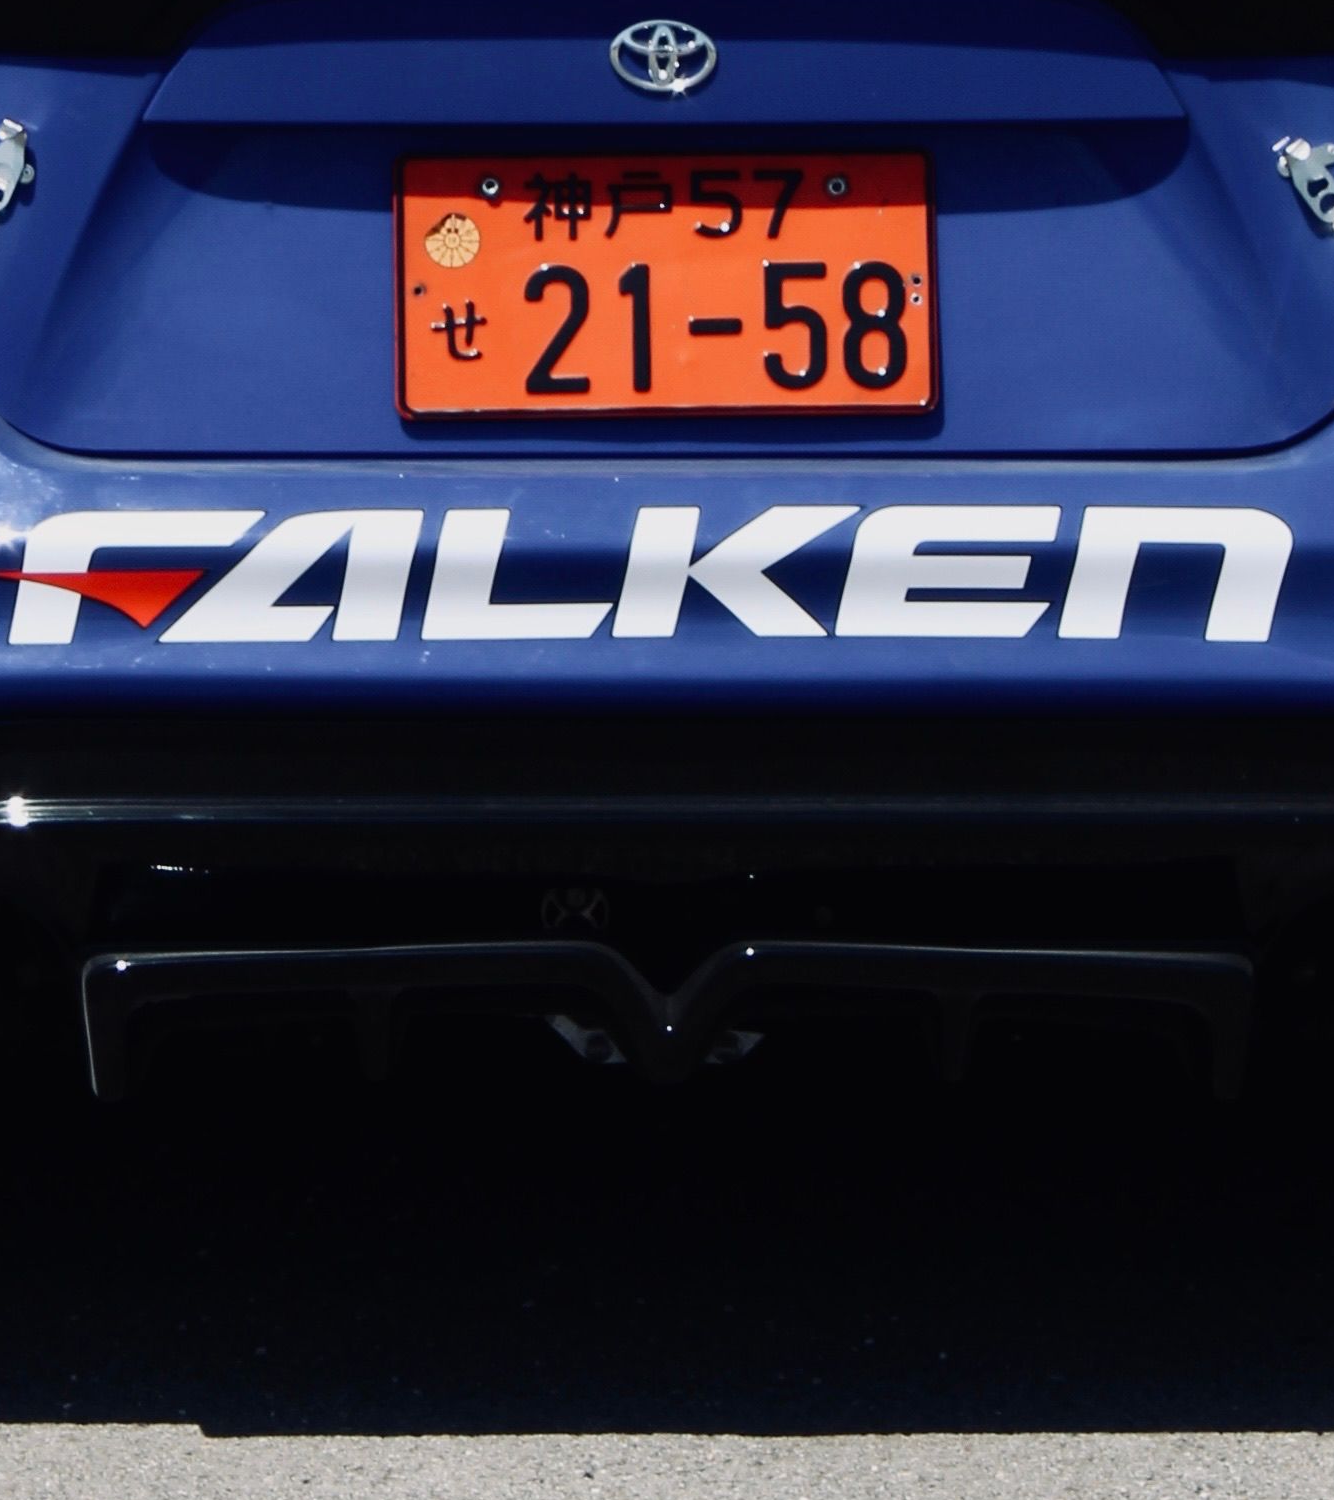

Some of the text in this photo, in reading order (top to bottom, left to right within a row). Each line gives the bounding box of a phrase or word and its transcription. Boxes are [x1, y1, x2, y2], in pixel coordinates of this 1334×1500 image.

[524, 171, 673, 241] 神戸
[689, 169, 804, 239] 57
[430, 260, 908, 395] せ 21-58
[2, 505, 1296, 645] FALKEN
